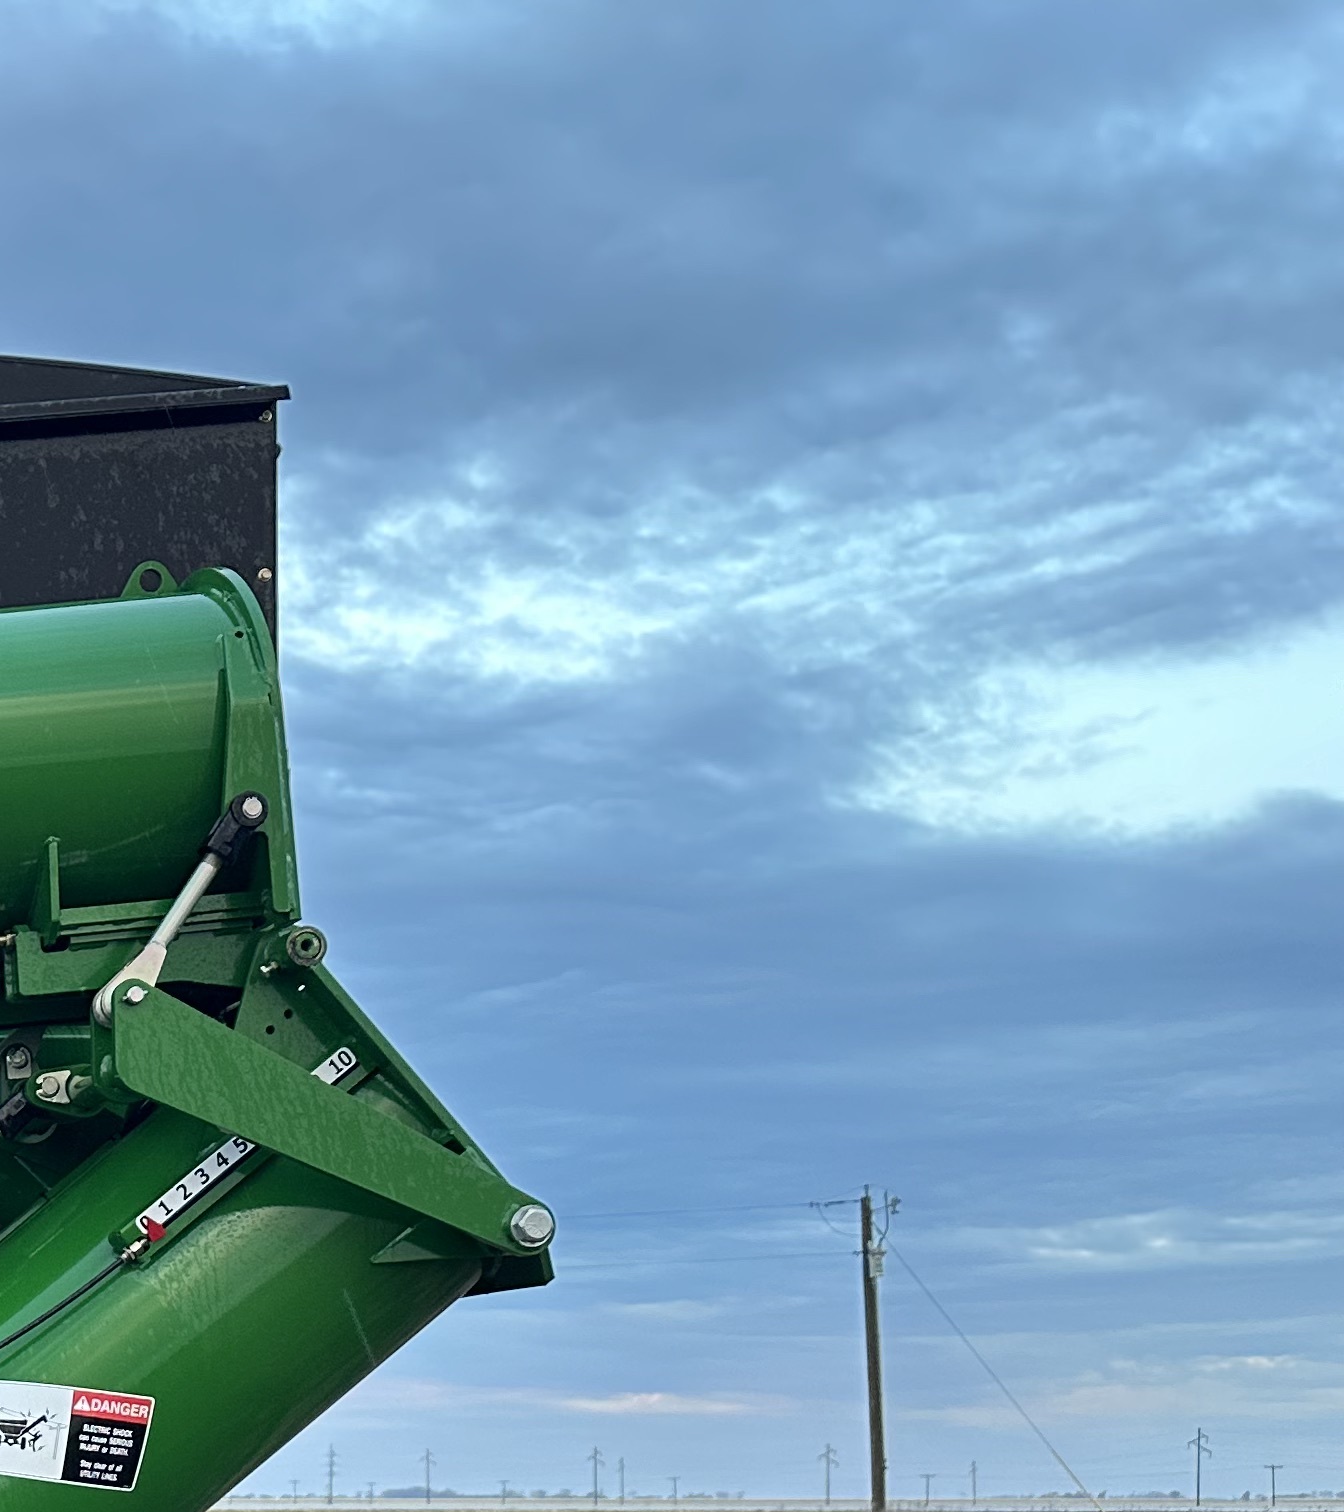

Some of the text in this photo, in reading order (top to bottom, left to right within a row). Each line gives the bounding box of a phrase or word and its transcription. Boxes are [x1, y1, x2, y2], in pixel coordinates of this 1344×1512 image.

[158, 1200, 173, 1216] 1
[175, 1183, 193, 1201] 2
[194, 1168, 211, 1185] 3
[215, 1151, 229, 1168] 4
[232, 1137, 249, 1154] 5
[328, 1050, 353, 1075] 10
[90, 1398, 149, 1418] DANGER
[112, 1428, 133, 1438] SHOCK
